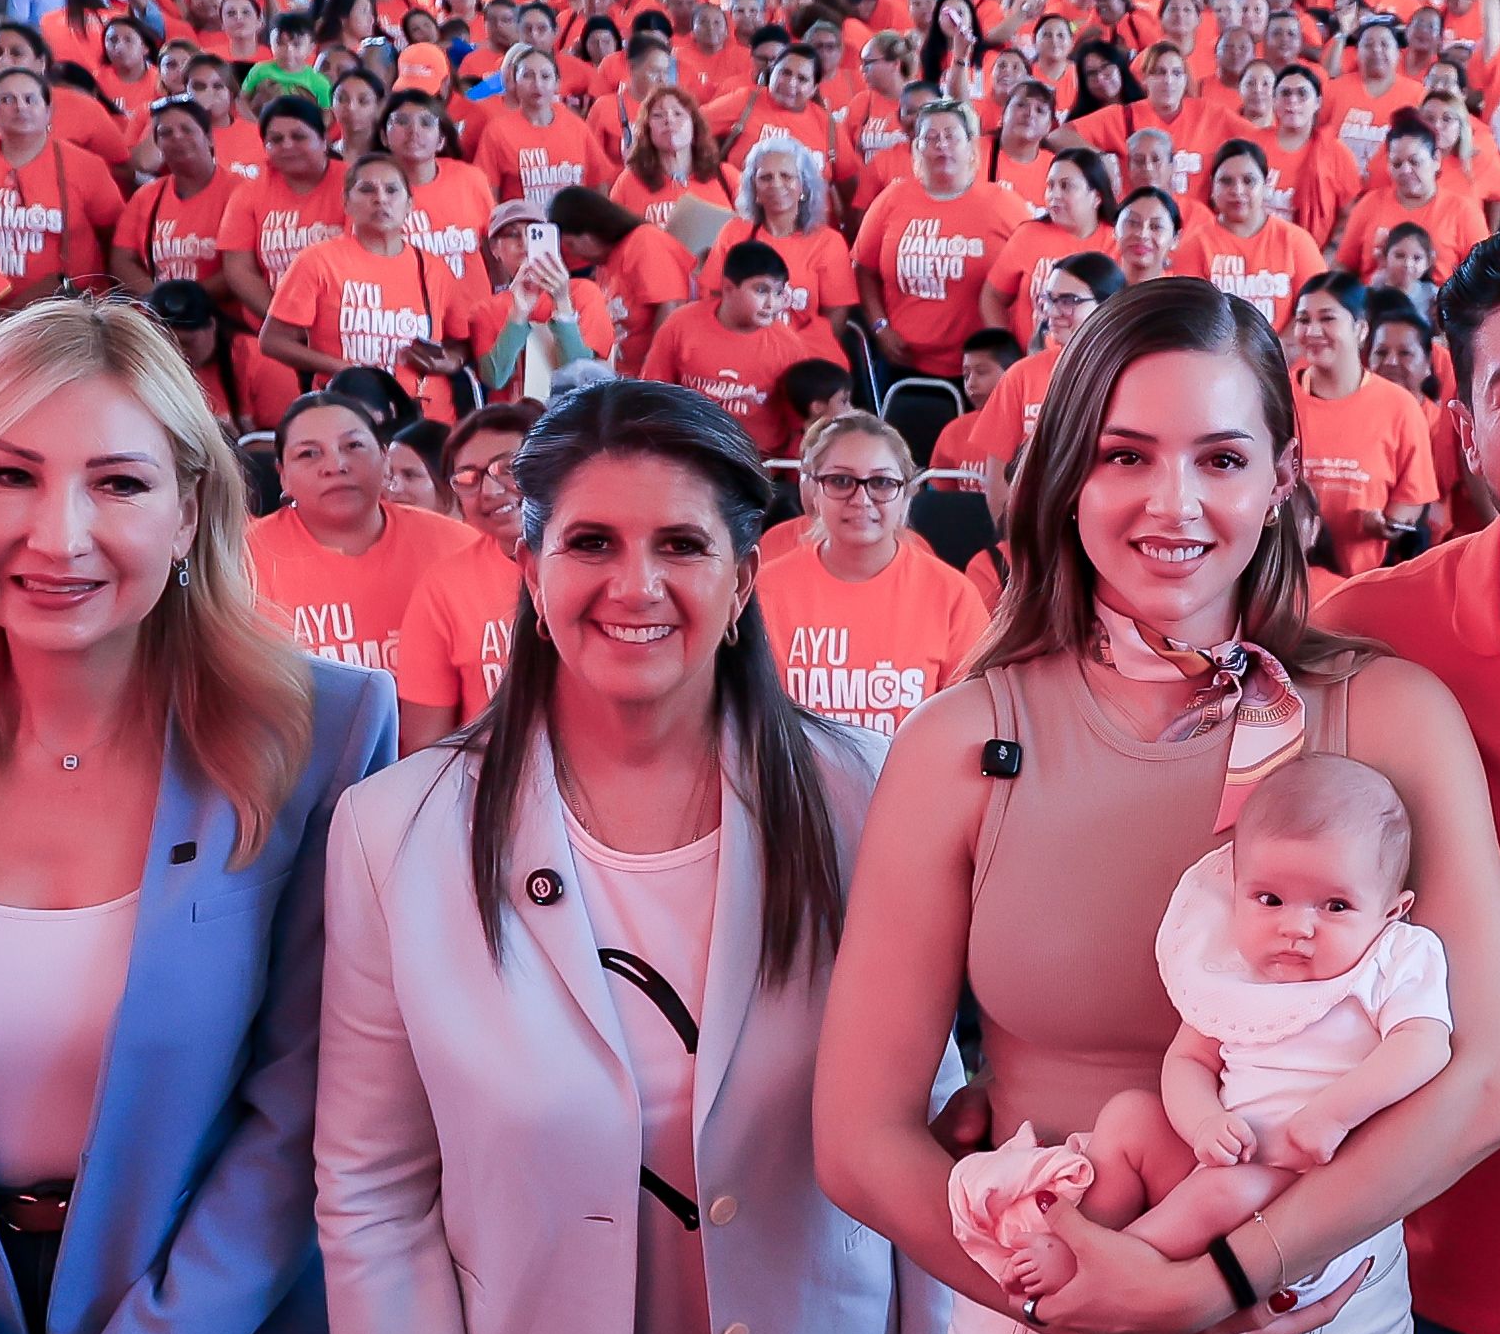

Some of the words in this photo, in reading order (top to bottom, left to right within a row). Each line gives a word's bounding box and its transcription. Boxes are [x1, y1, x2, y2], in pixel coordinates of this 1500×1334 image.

[519, 148, 550, 168] AYU
[155, 219, 178, 239] YU
[262, 210, 300, 230] AYU
[902, 218, 942, 238] AYU
[899, 234, 984, 258] DAMOS
[897, 254, 965, 282] NUEVO
[341, 279, 382, 308] AYU
[340, 333, 411, 366] NUEV
[293, 603, 355, 643] AYU
[481, 618, 514, 661] AY
[788, 626, 849, 666] AYU
[786, 660, 926, 710] DAMOS
